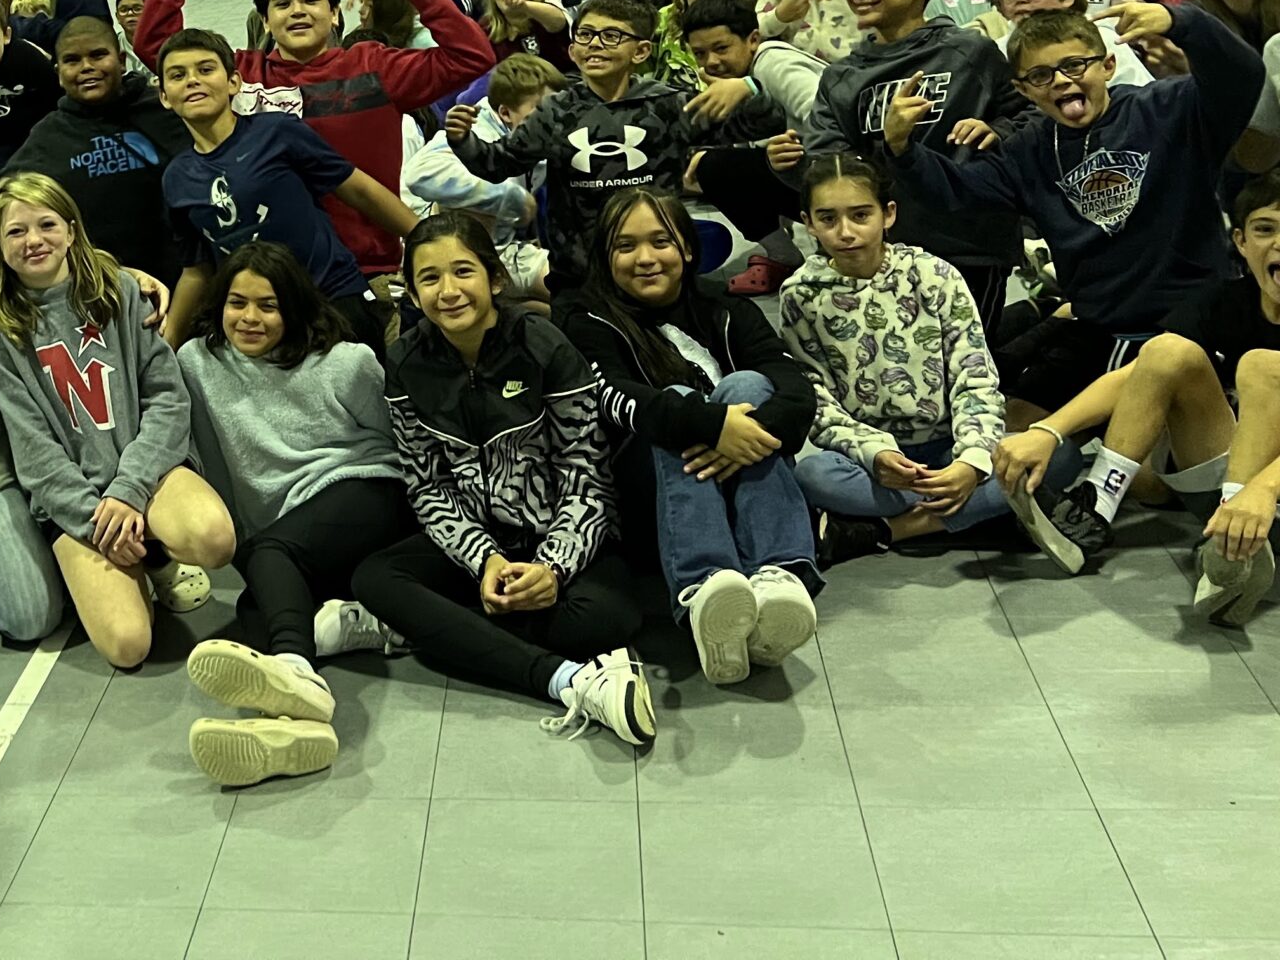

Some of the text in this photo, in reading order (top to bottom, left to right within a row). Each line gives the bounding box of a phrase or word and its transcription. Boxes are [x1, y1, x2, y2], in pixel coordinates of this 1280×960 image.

[70, 146, 126, 170] NORTH
[87, 157, 129, 178] FACE
[569, 174, 653, 188] UNDER ARMOUR
[35, 340, 116, 434] N
